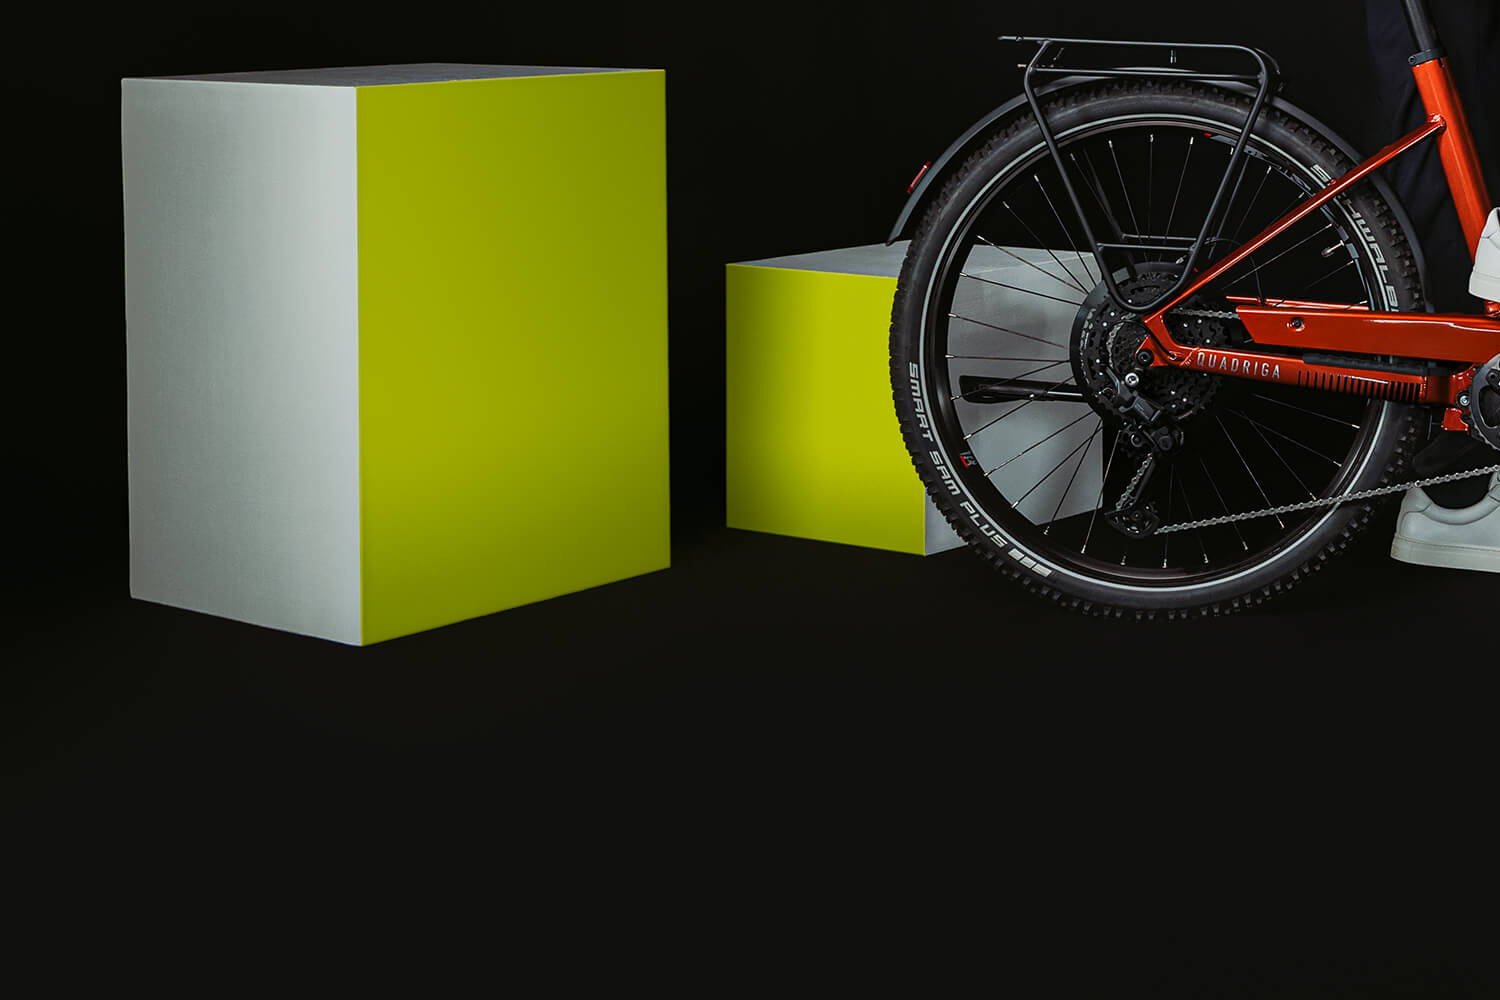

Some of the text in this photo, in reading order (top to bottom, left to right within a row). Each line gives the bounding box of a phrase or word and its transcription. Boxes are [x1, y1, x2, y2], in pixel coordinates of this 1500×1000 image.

[1196, 351, 1281, 379] QUADRIGA
[908, 360, 934, 443] SMART
[928, 449, 962, 497] SAM
[959, 500, 1009, 549] PLUS
